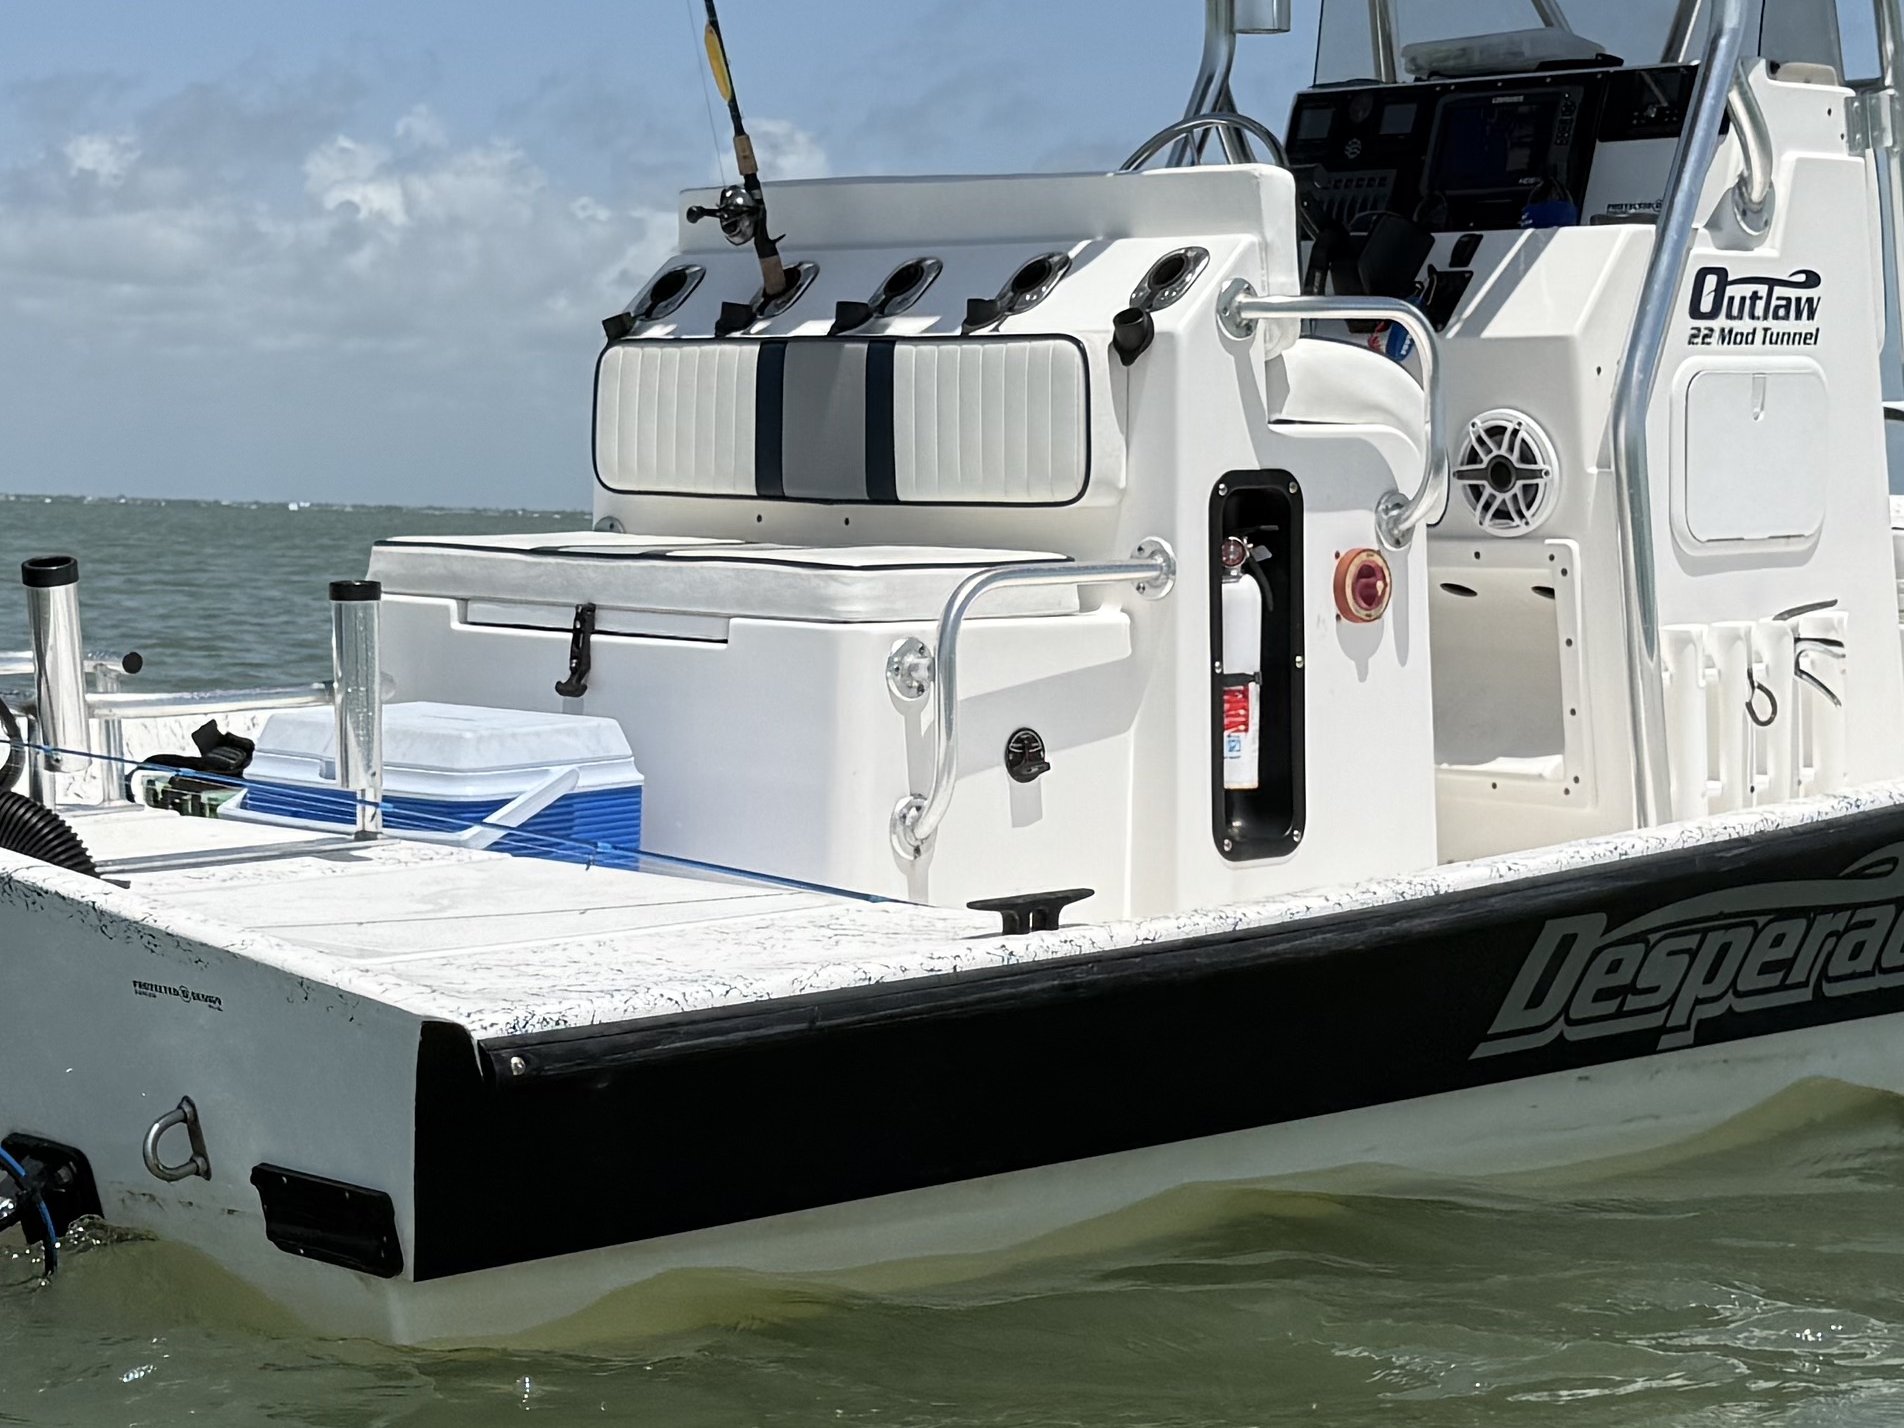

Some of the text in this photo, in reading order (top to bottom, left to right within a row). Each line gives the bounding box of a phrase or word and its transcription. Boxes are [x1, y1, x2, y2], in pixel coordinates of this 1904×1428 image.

[1688, 266, 1821, 322] Outlaw
[1687, 326, 1820, 346] 22 Mod Tunnel
